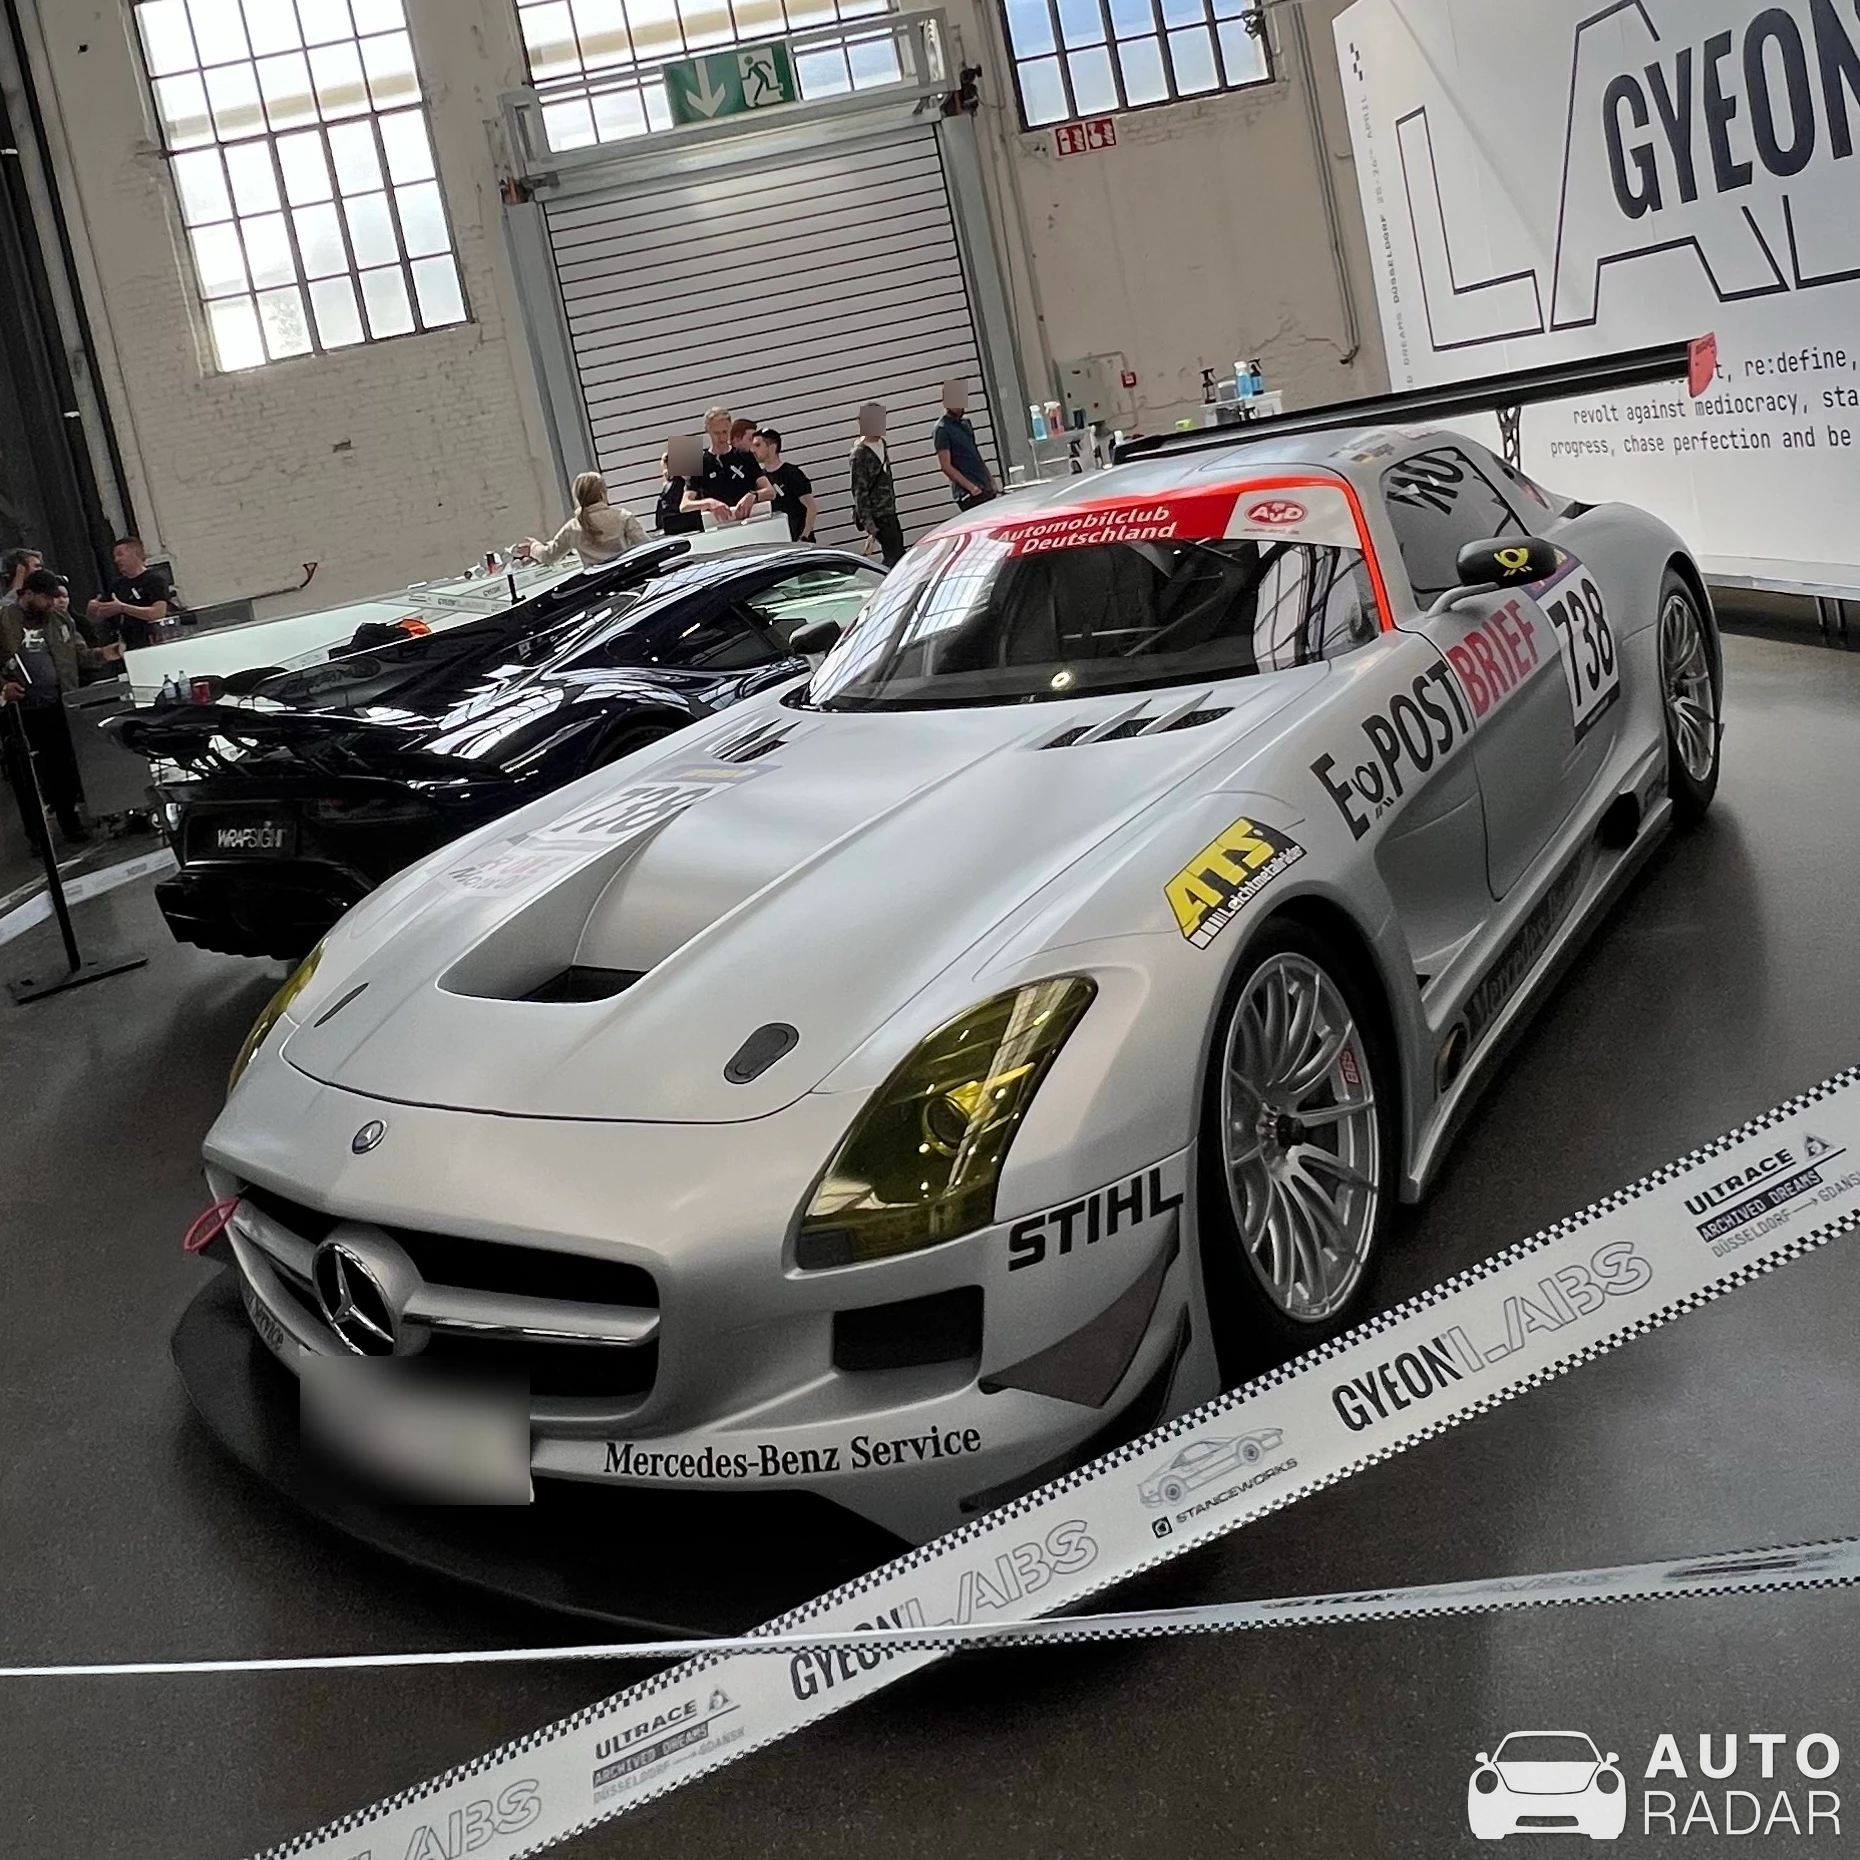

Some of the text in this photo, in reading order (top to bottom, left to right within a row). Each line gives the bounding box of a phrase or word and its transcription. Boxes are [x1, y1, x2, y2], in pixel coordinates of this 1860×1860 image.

[1744, 347, 1857, 378] re:define,
[1573, 404, 1619, 424] revolt
[1626, 400, 1686, 424] against
[1695, 391, 1809, 416] mediocracy,
[1550, 425, 1852, 458] progress, chase perfection and be
[999, 506, 1170, 543] Automobilclub
[1021, 522, 1178, 555] Deutschland
[1547, 578, 1614, 707] 738
[1165, 818, 1275, 938] ATS
[1684, 1148, 1794, 1216] ULTRACE
[1700, 1170, 1822, 1241] ARCHIVED DREAMS
[1007, 1168, 1184, 1271] STIHL
[1711, 1207, 1794, 1259] DÜSSELDORF
[1331, 1336, 1464, 1432] GYEON
[604, 1424, 982, 1478] Mercedes-Benz Service
[1176, 1458, 1298, 1524] STANCEWORKS
[595, 1699, 698, 1760] ULTRACE
[593, 1748, 657, 1785] ARCHIVED
